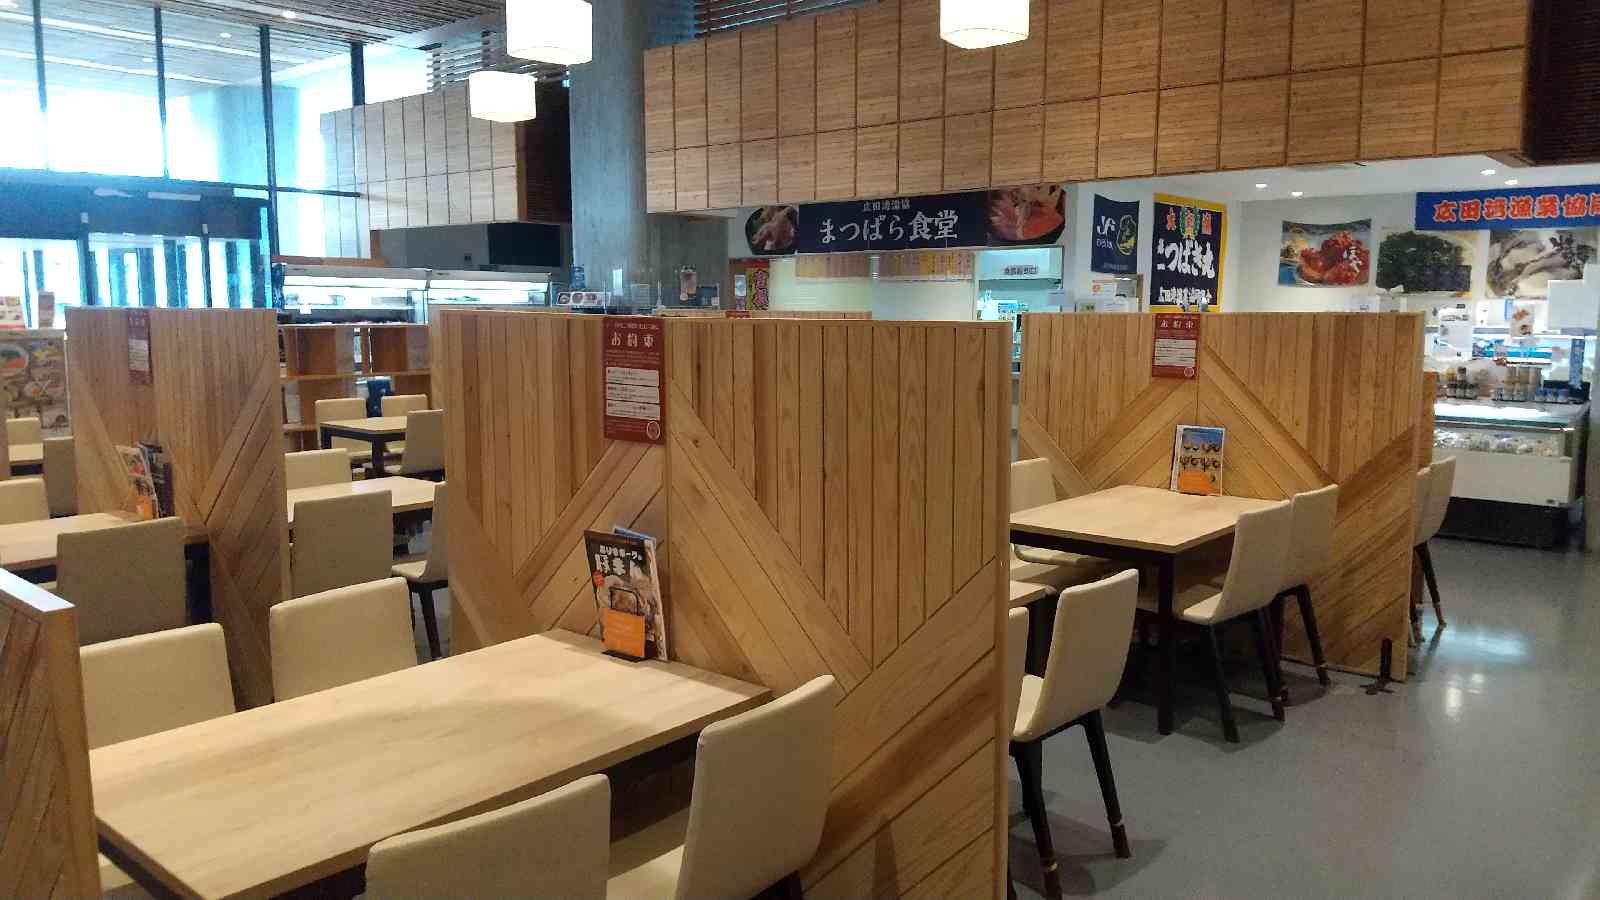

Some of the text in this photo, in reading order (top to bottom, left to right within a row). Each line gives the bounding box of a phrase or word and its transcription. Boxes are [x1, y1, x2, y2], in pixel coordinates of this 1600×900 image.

[818, 209, 960, 245] まつばら食堂
